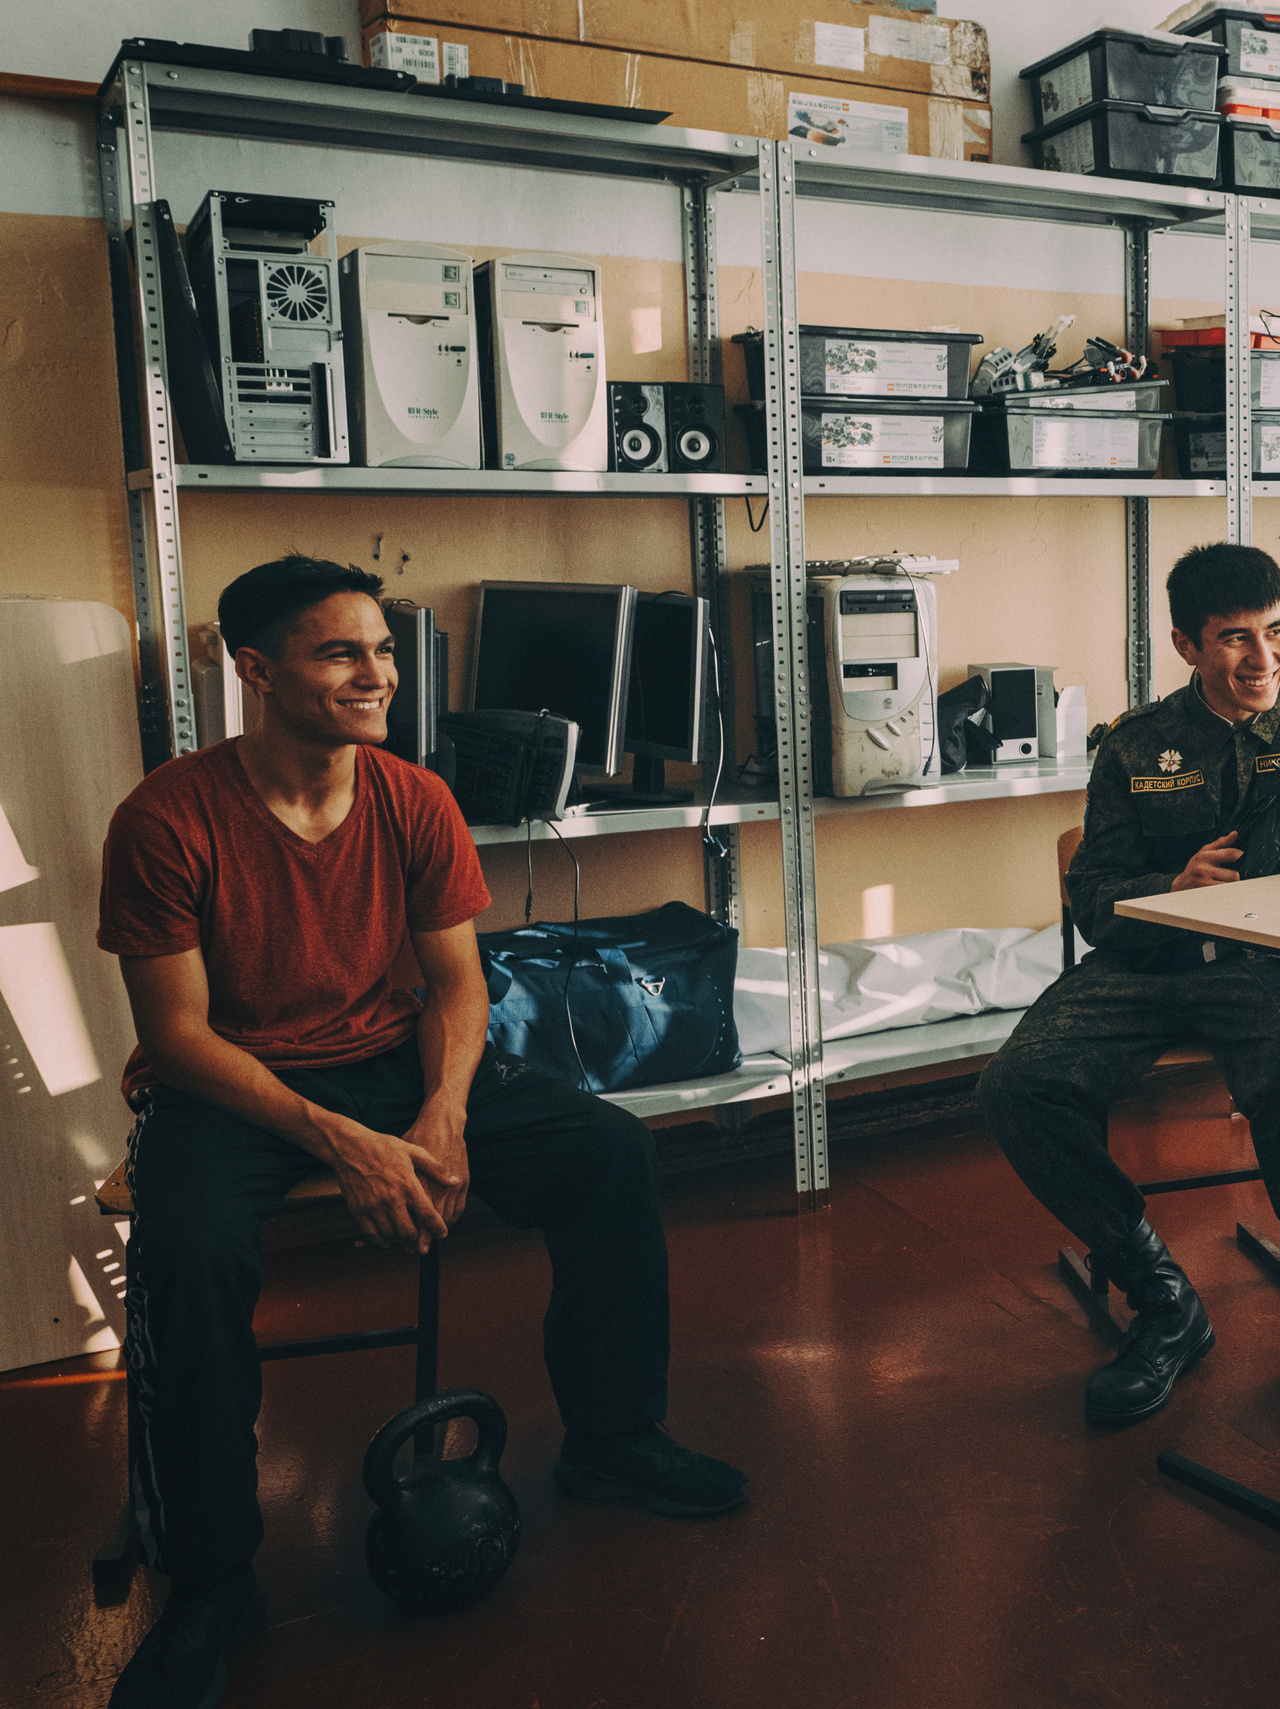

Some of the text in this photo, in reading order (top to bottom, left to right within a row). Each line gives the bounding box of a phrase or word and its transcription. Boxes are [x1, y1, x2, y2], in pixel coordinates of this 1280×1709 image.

[895, 382, 943, 390] mindstorms
[1134, 773, 1201, 790] КАДЕТСКИЙ КОРПУС
